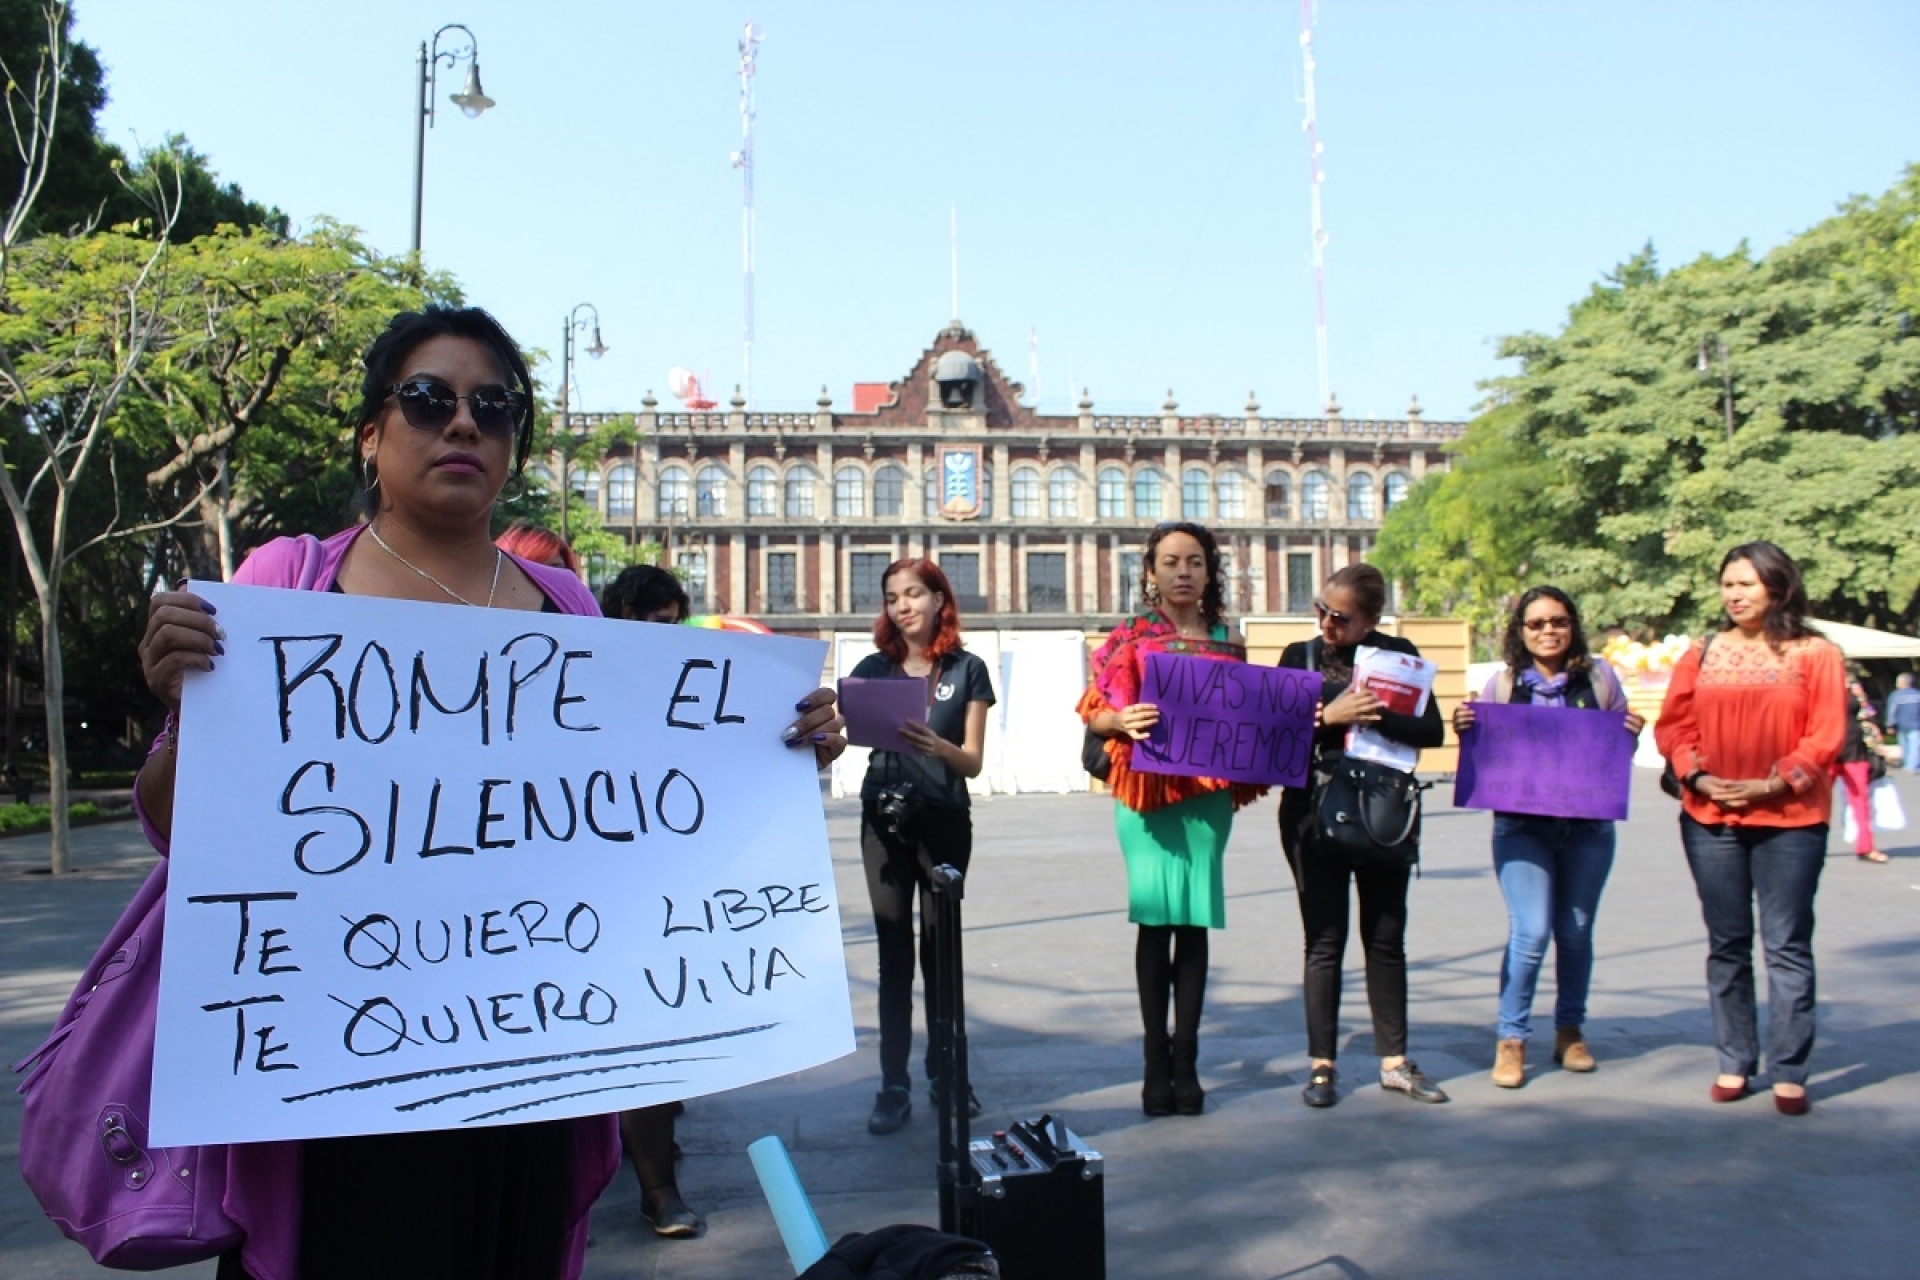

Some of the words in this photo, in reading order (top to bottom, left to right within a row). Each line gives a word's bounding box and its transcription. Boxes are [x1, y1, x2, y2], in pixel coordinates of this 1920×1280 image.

[258, 633, 601, 746] ROMPE
[665, 658, 746, 731] EL
[1152, 655, 1247, 711] VIVAS
[1257, 671, 1313, 721] NOS
[279, 761, 706, 876] SILENCIO
[187, 891, 302, 976] TE
[340, 901, 602, 972] QUIERO
[662, 881, 830, 939] LIBRE
[200, 995, 301, 1076] TE
[327, 981, 618, 1057] QUIERO
[644, 946, 807, 1009] VIVA
